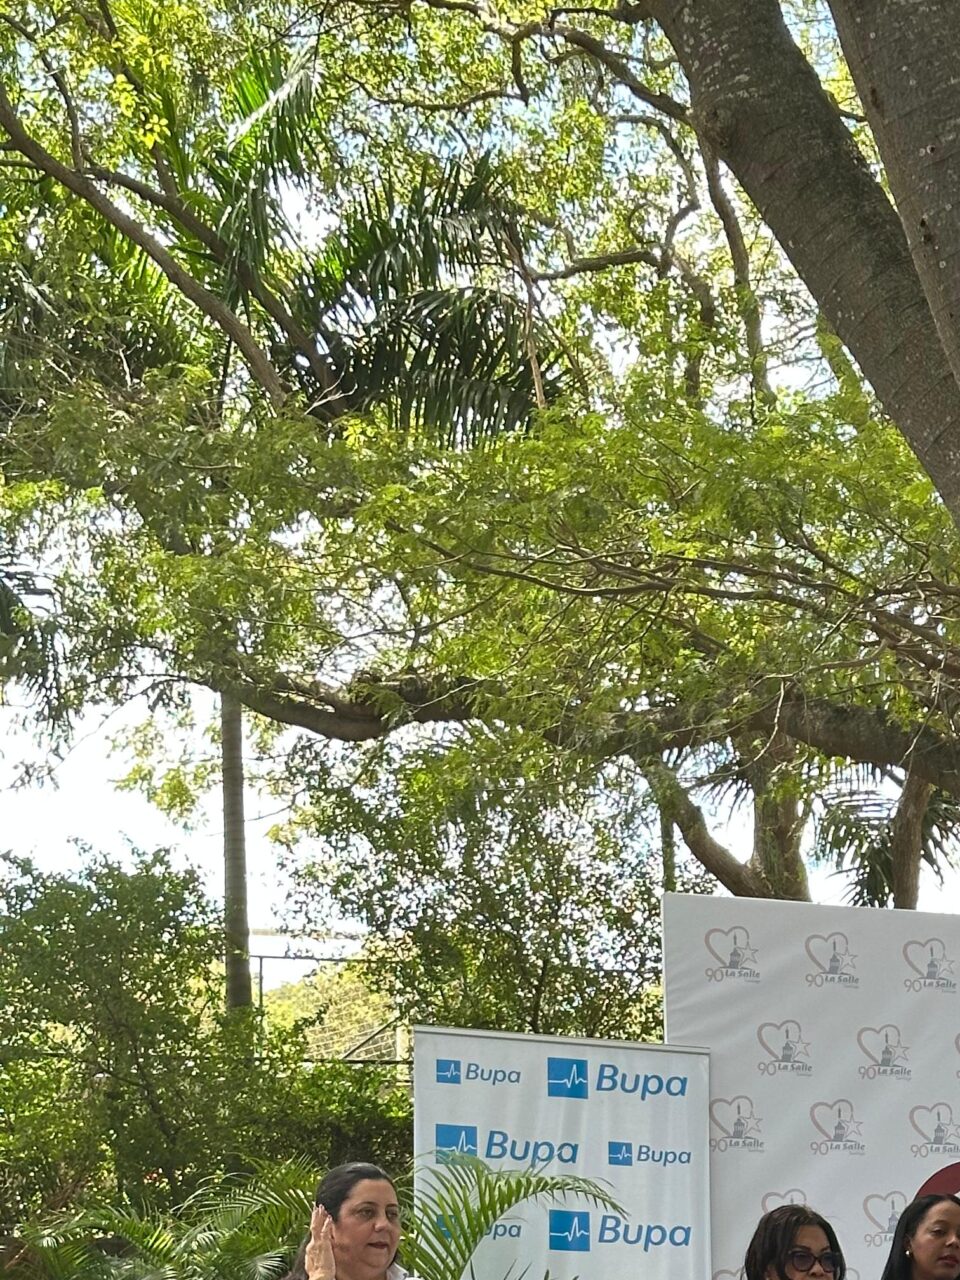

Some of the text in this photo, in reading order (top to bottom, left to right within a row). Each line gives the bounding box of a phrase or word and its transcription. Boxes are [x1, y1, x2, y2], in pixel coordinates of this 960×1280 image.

[705, 968, 760, 982] 90 La Salle
[806, 974, 824, 987] 90
[838, 976, 859, 984] Salle
[904, 979, 922, 992] 90
[935, 980, 957, 988] Salle
[465, 1063, 522, 1086] Bupa
[758, 1062, 776, 1076] 90
[790, 1064, 812, 1072] Salle
[858, 1066, 876, 1080] 90
[890, 1068, 912, 1076] Salle
[596, 1064, 688, 1100] Bupa
[485, 1130, 579, 1169] Bupa
[709, 1138, 728, 1152] 90
[742, 1140, 764, 1148] Salle
[810, 1142, 828, 1155] 90
[910, 1144, 928, 1158] 90
[636, 1145, 692, 1166] Bupa
[598, 1215, 692, 1252] Bupa
[864, 1234, 882, 1247] 90
